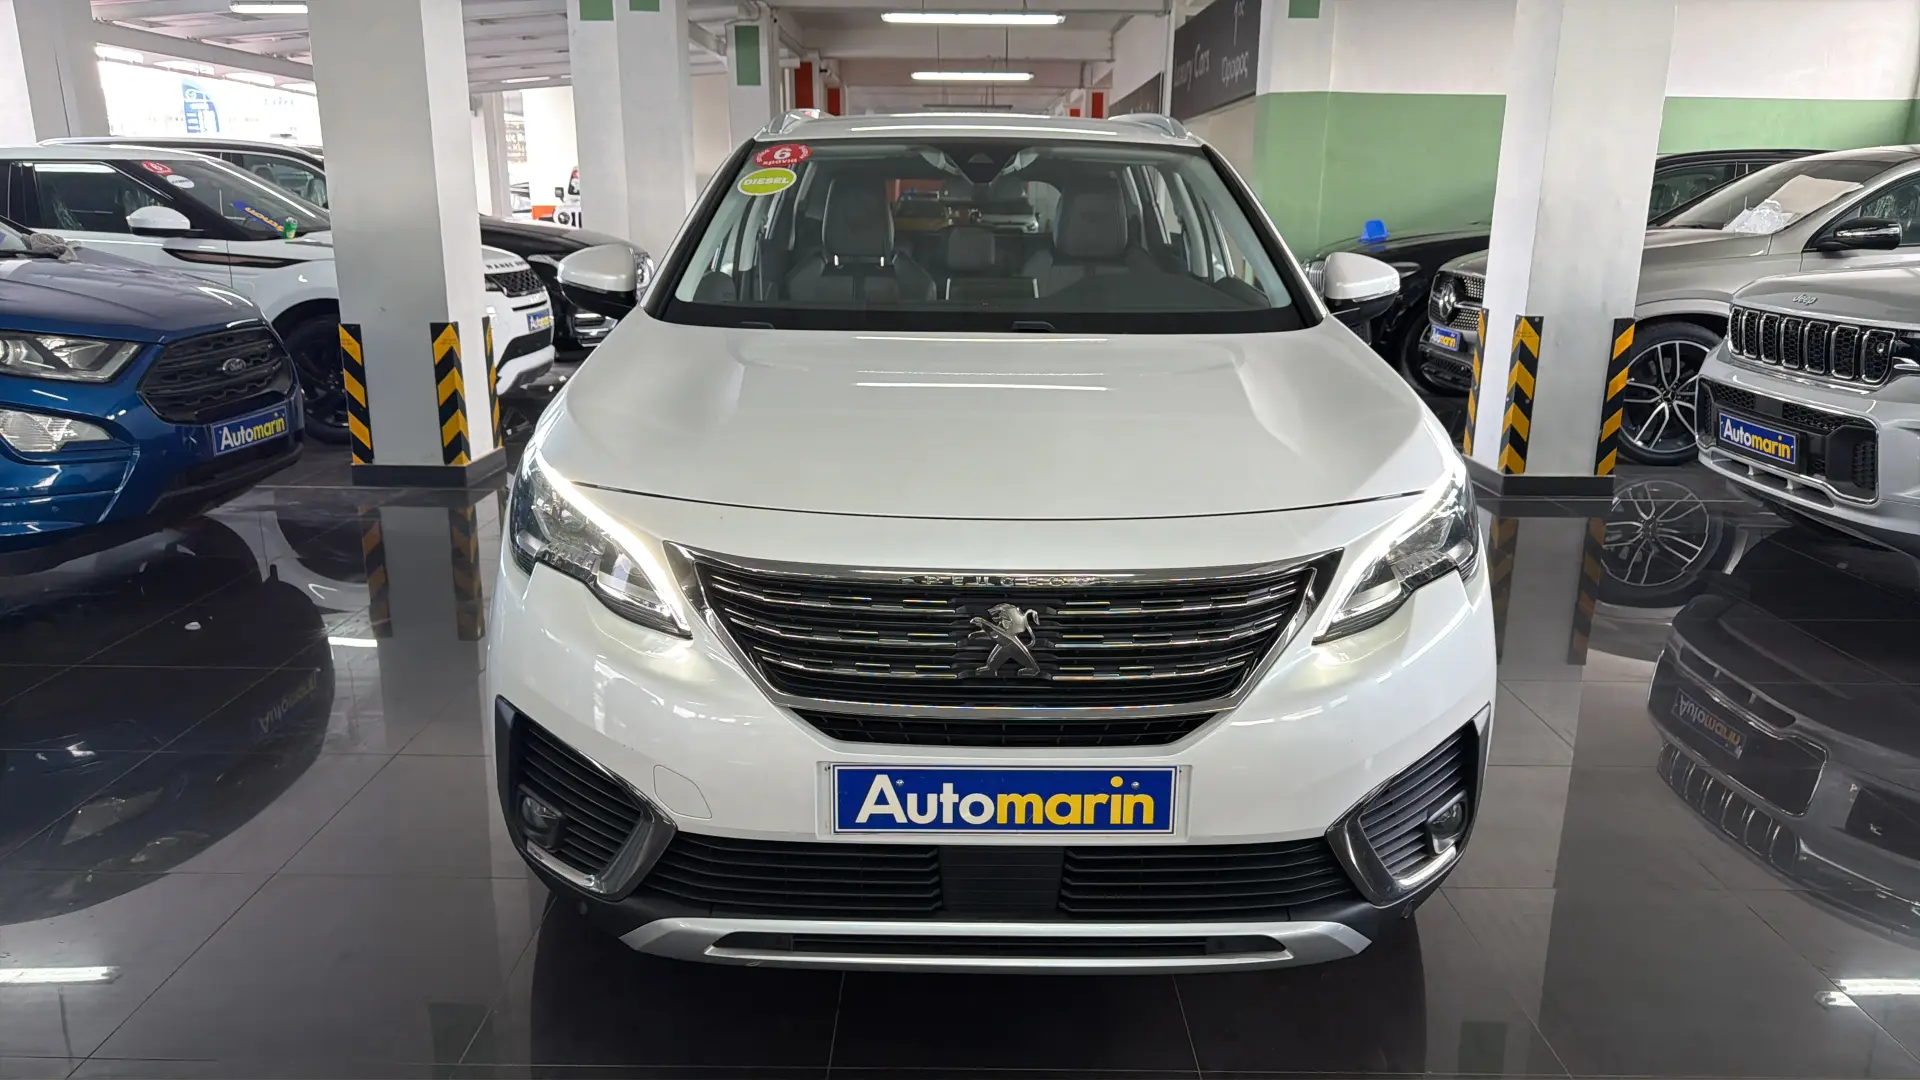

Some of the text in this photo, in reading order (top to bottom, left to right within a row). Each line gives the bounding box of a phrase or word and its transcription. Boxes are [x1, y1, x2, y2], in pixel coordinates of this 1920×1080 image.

[774, 147, 793, 160] 6
[743, 177, 789, 185] DIESEL
[1792, 293, 1818, 305] Jeep
[220, 412, 286, 451] Automarin
[1723, 418, 1792, 460] Automarin
[855, 773, 1155, 826] Automarin
